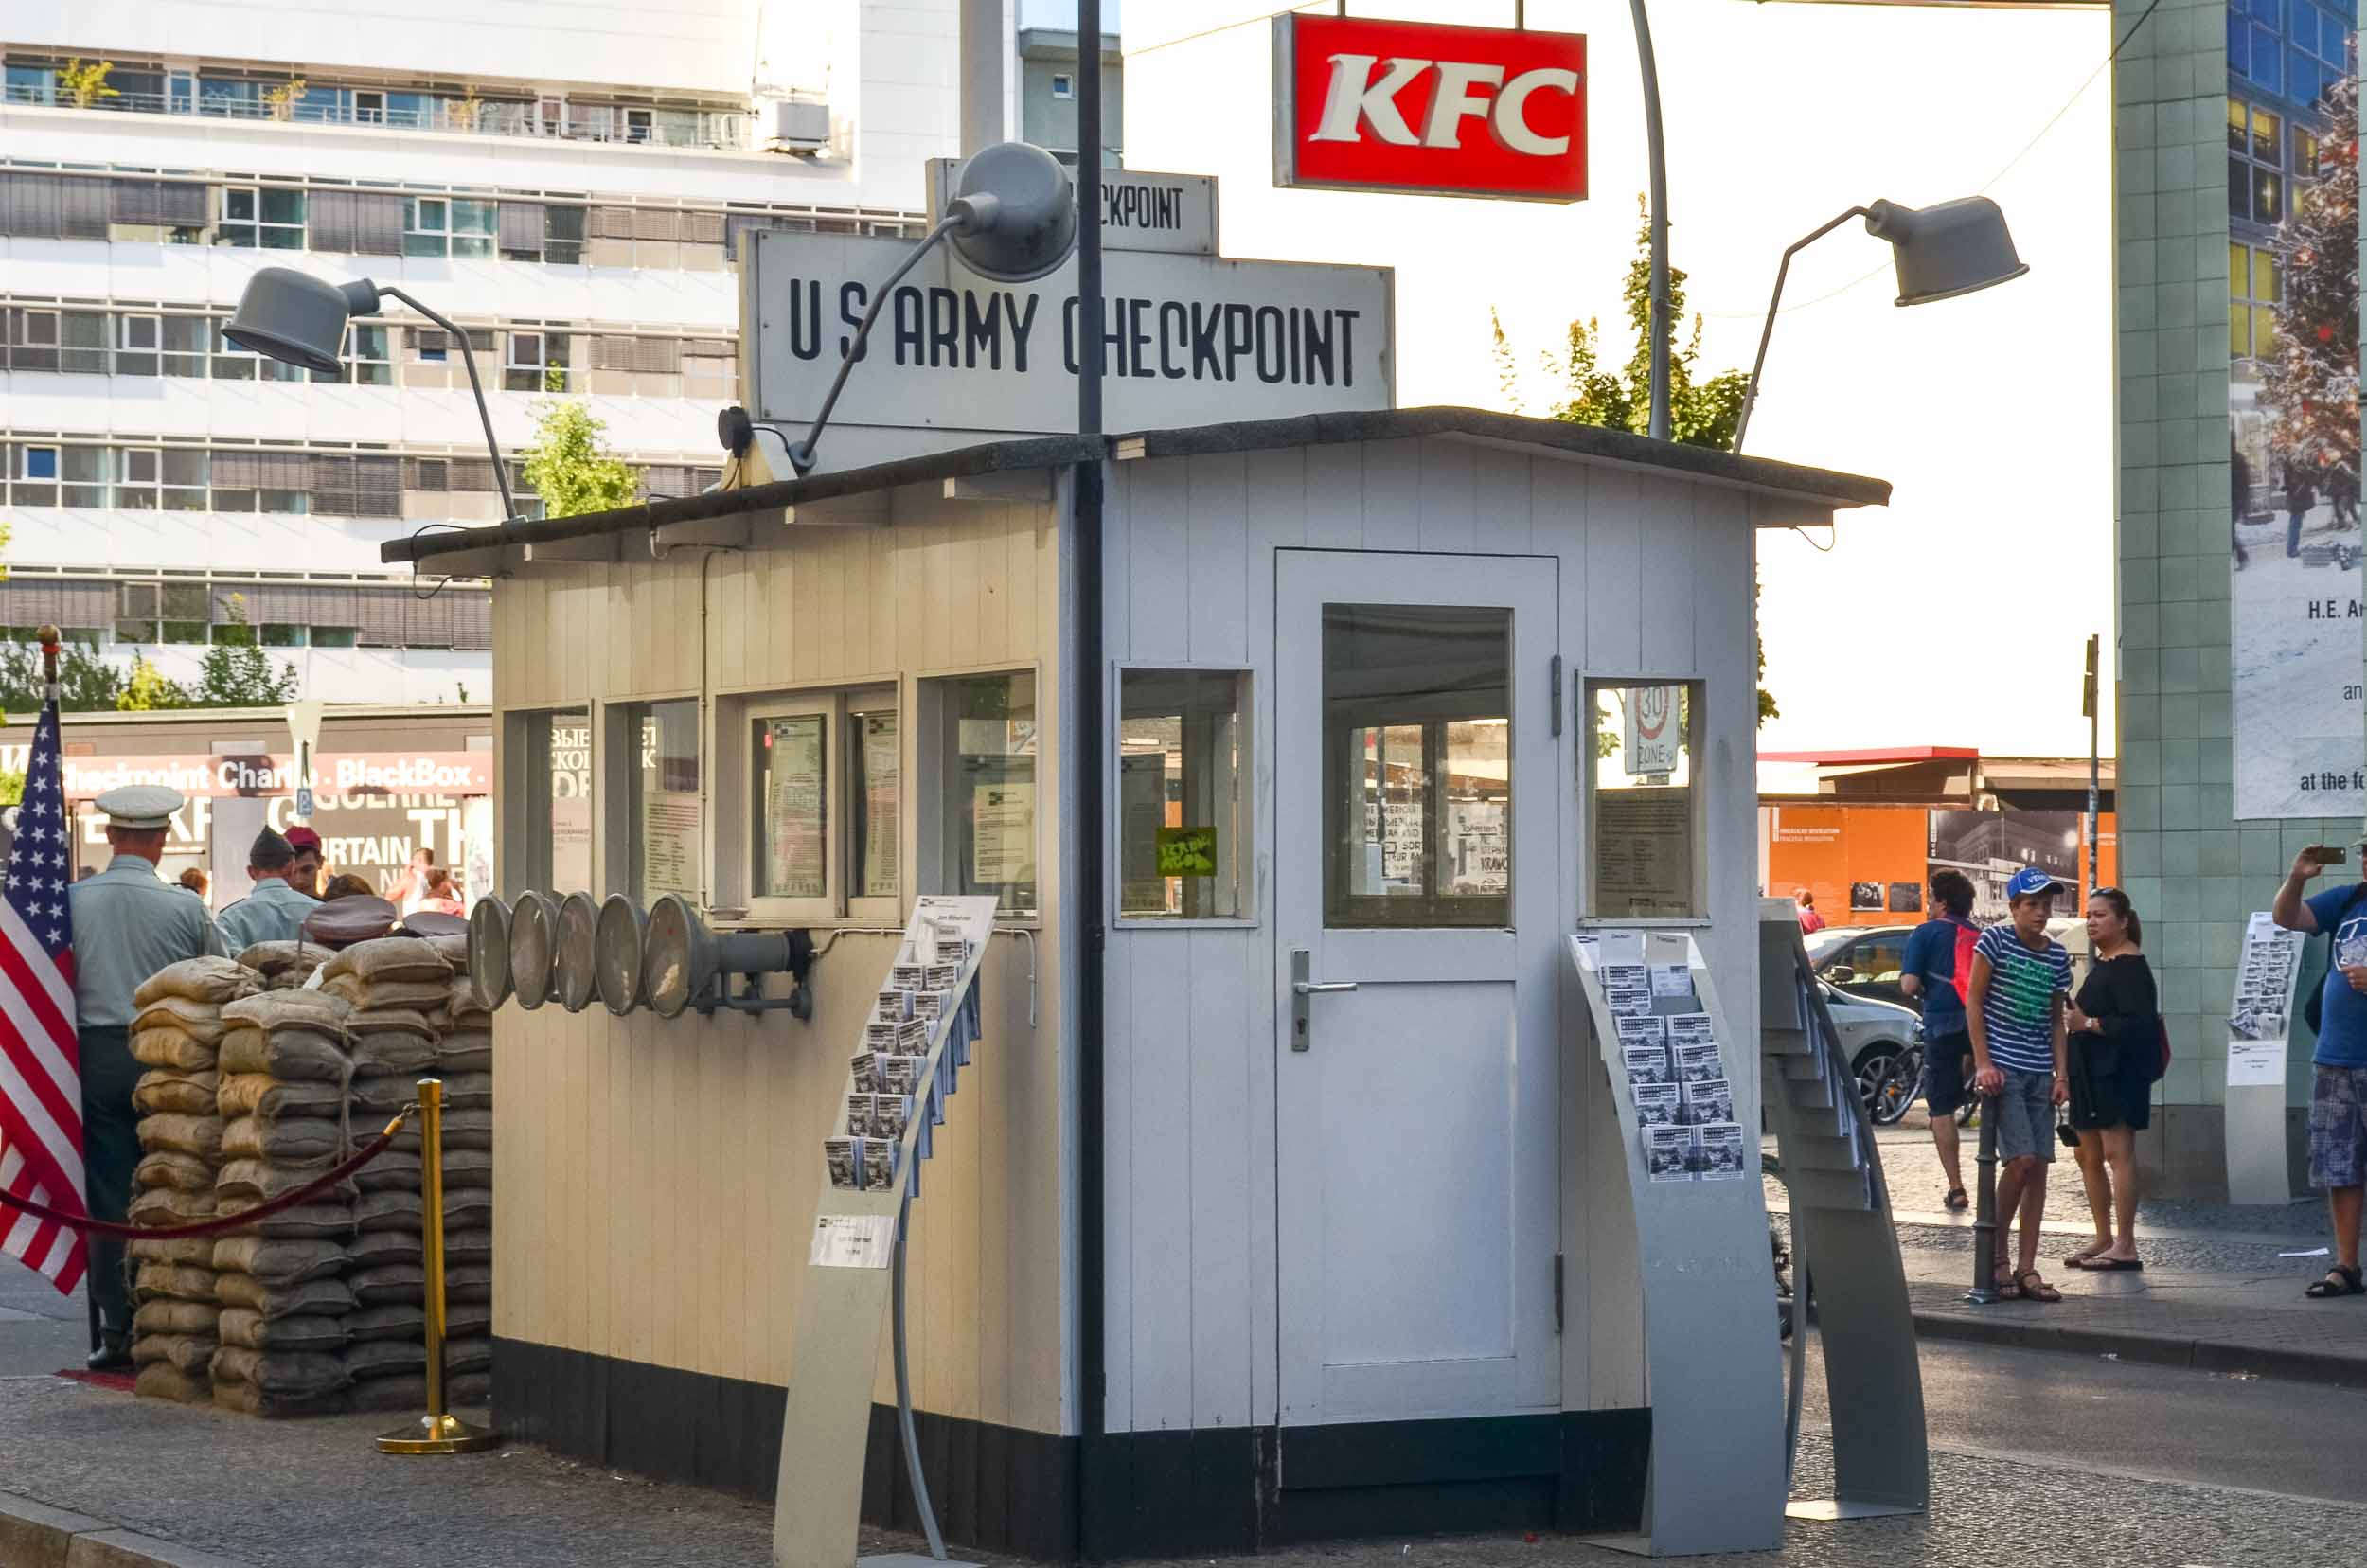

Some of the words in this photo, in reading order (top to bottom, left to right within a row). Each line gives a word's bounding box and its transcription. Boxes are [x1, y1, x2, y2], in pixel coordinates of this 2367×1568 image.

[1308, 53, 1579, 156] KFC
[1068, 181, 1184, 230] CKPOINT
[894, 286, 1040, 373] ARMY
[1062, 295, 1361, 387] CHECKPOINT
[2309, 599, 2341, 620] H.E.
[336, 759, 472, 789] BlackBox
[2301, 772, 2317, 791] at
[2322, 771, 2348, 791] the
